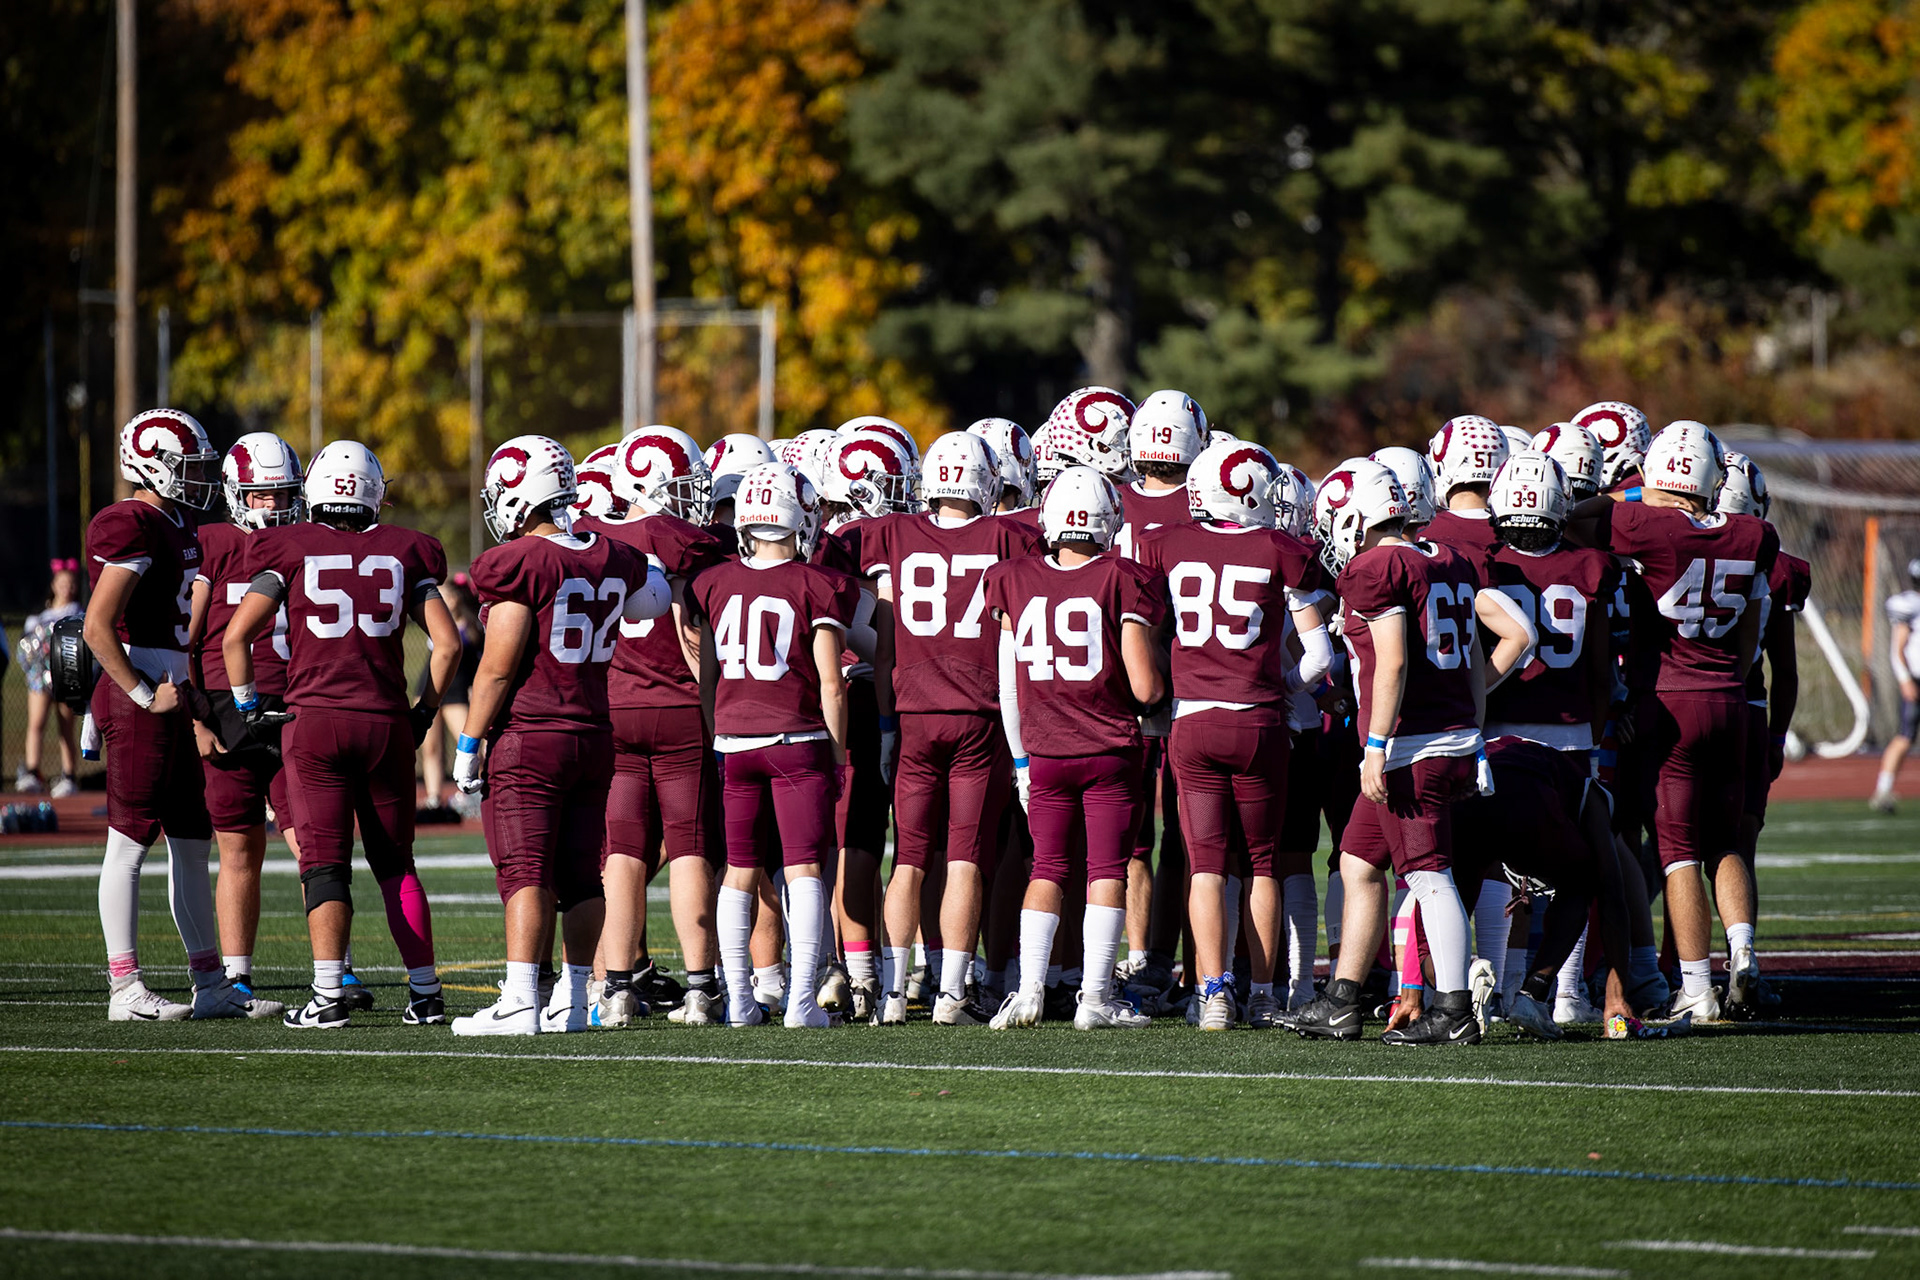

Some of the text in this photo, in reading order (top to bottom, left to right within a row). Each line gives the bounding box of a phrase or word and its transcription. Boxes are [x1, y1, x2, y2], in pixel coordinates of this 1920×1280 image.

[1152, 426, 1172, 444] 19
[1140, 450, 1180, 462] Riddell
[1474, 451, 1492, 468] 51
[939, 466, 964, 483] 87
[1578, 457, 1596, 476] 16
[1666, 457, 1692, 475] 45
[334, 478, 357, 497] 53
[936, 487, 965, 495] schutt
[1656, 479, 1697, 492] Riddell
[745, 488, 772, 505] 40
[1512, 490, 1538, 508] 39
[322, 503, 364, 514] Riddell
[740, 514, 778, 523] Riddell
[1066, 510, 1088, 526] 49
[1510, 514, 1540, 523] schutt
[1061, 532, 1090, 540] schutt
[304, 554, 404, 639] 53
[899, 552, 999, 639] 87
[1657, 558, 1756, 639] 45
[1168, 561, 1272, 650] 85
[549, 577, 628, 663] 62
[714, 594, 796, 681] 40
[1014, 595, 1103, 682] 49
